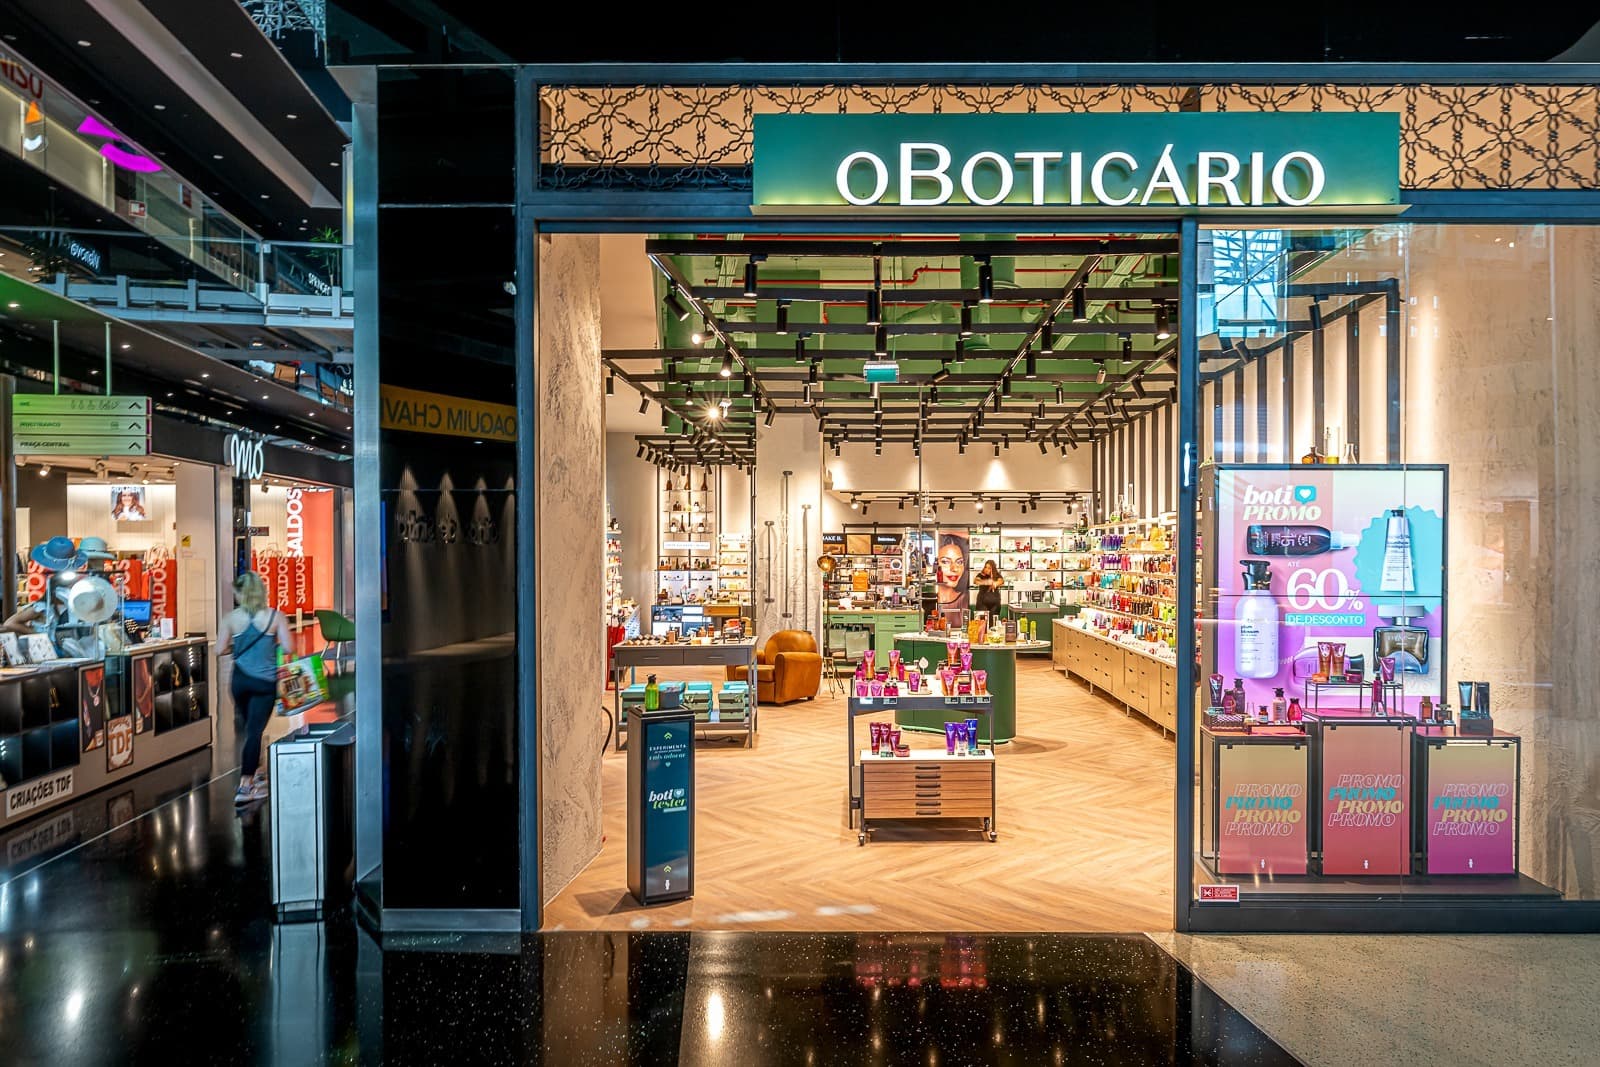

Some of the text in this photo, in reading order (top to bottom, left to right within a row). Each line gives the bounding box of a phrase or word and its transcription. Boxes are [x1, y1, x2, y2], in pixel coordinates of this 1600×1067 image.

[1243, 484, 1293, 505] boti
[1243, 505, 1322, 521] PROMO
[1286, 568, 1364, 611] 60%
[1287, 615, 1363, 625] DE DESCONTO
[108, 728, 133, 757] TDF
[1337, 774, 1405, 788] PROMO
[10, 773, 72, 810] CRIAÇÕES TDF
[1234, 783, 1303, 798] PROMO
[1441, 783, 1509, 797] PROMO
[1337, 800, 1405, 814] PROMO
[1234, 809, 1302, 823] PROMO
[1328, 812, 1396, 827] PROMO
[1442, 809, 1508, 823] PROMO
[1224, 821, 1294, 837] PROMO
[1432, 821, 1500, 836] PROMO
